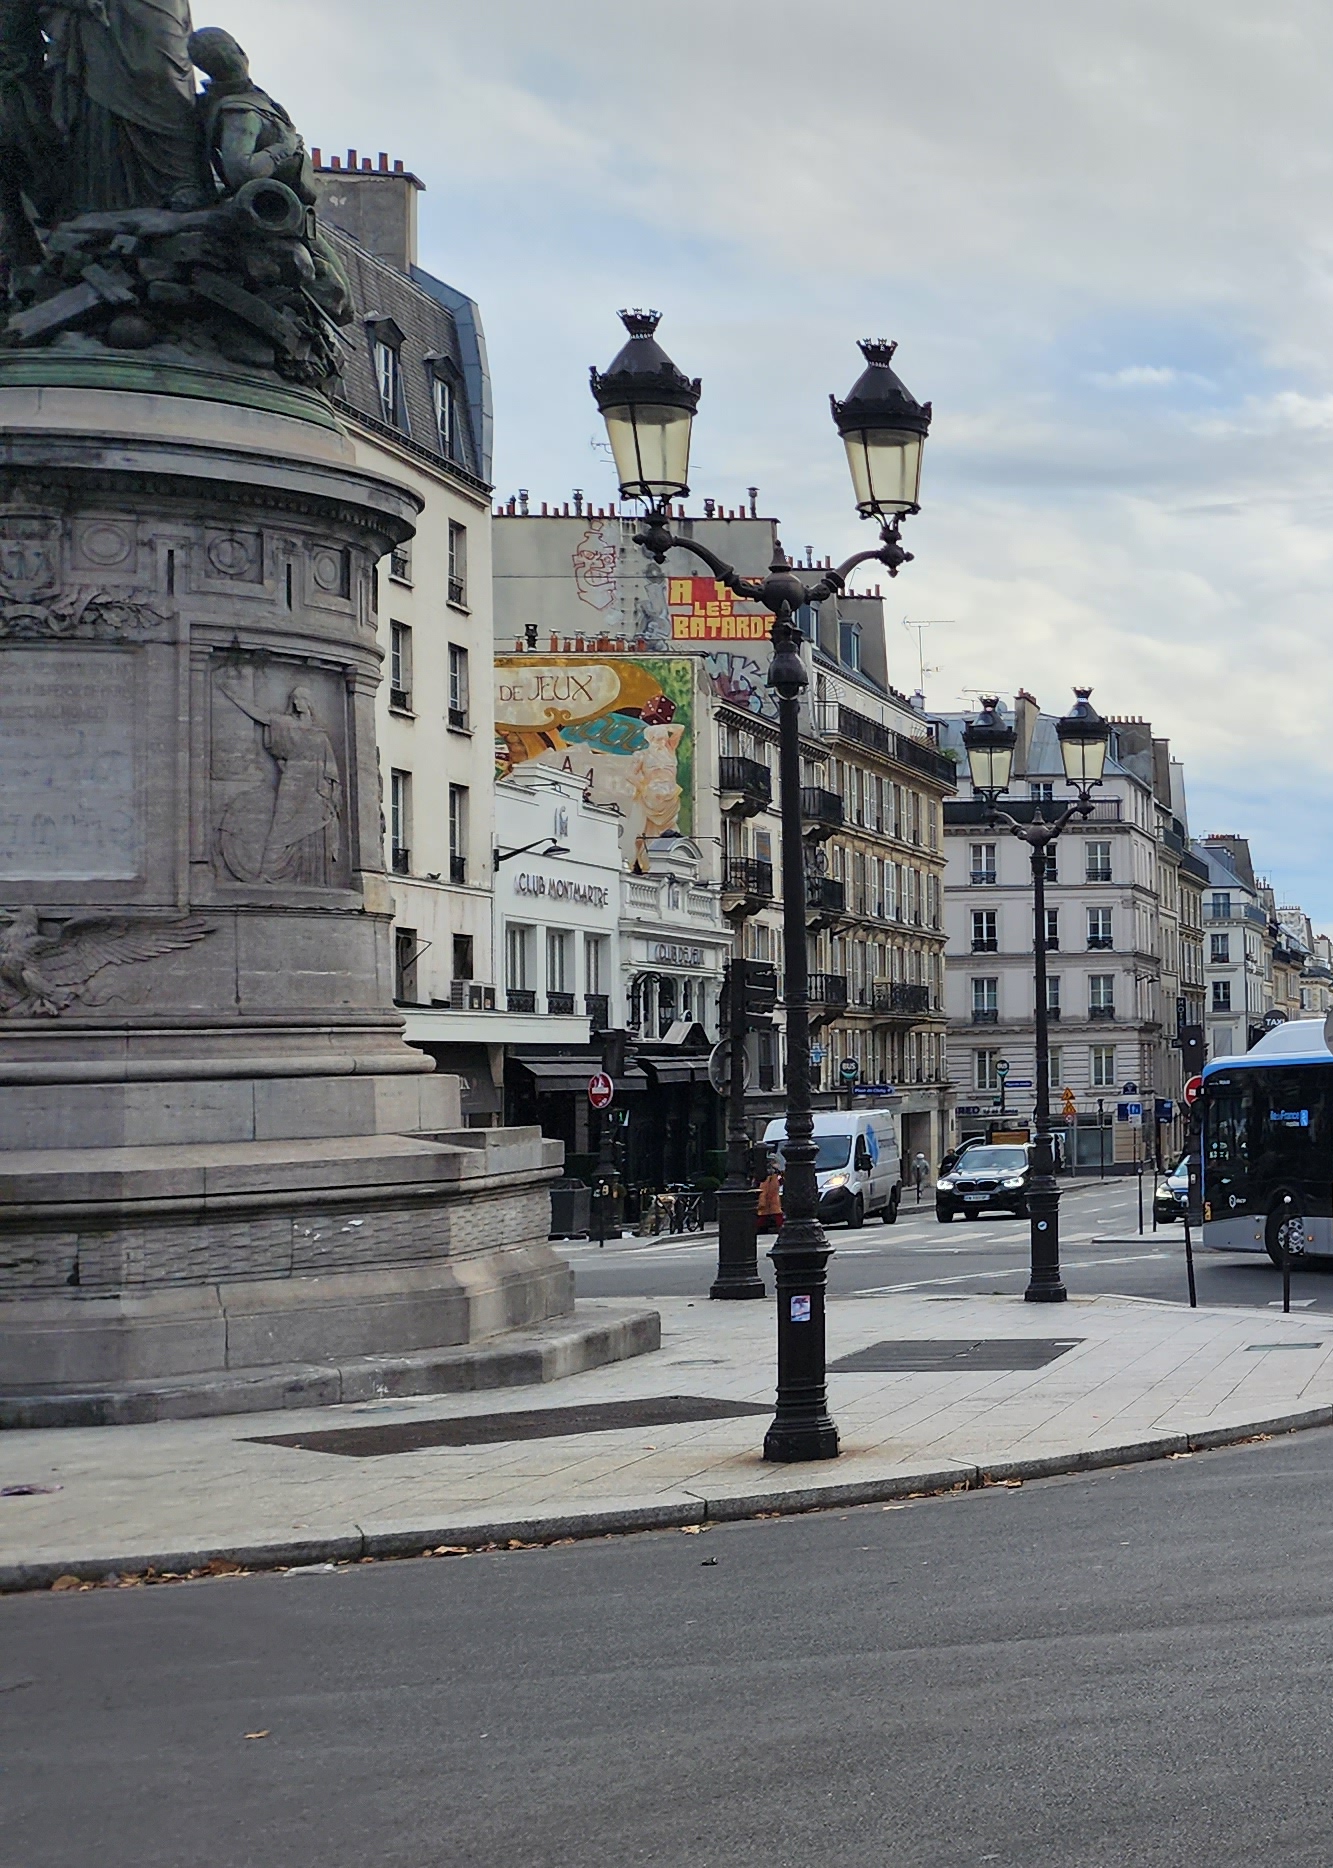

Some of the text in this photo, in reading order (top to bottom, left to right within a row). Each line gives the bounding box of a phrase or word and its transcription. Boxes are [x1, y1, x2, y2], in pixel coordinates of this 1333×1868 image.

[671, 580, 692, 603] A
[694, 602, 731, 615] LES
[674, 616, 776, 638] BATARDS
[500, 675, 593, 701] DE JEUX
[517, 872, 609, 908] CLUB MONTMARTRE
